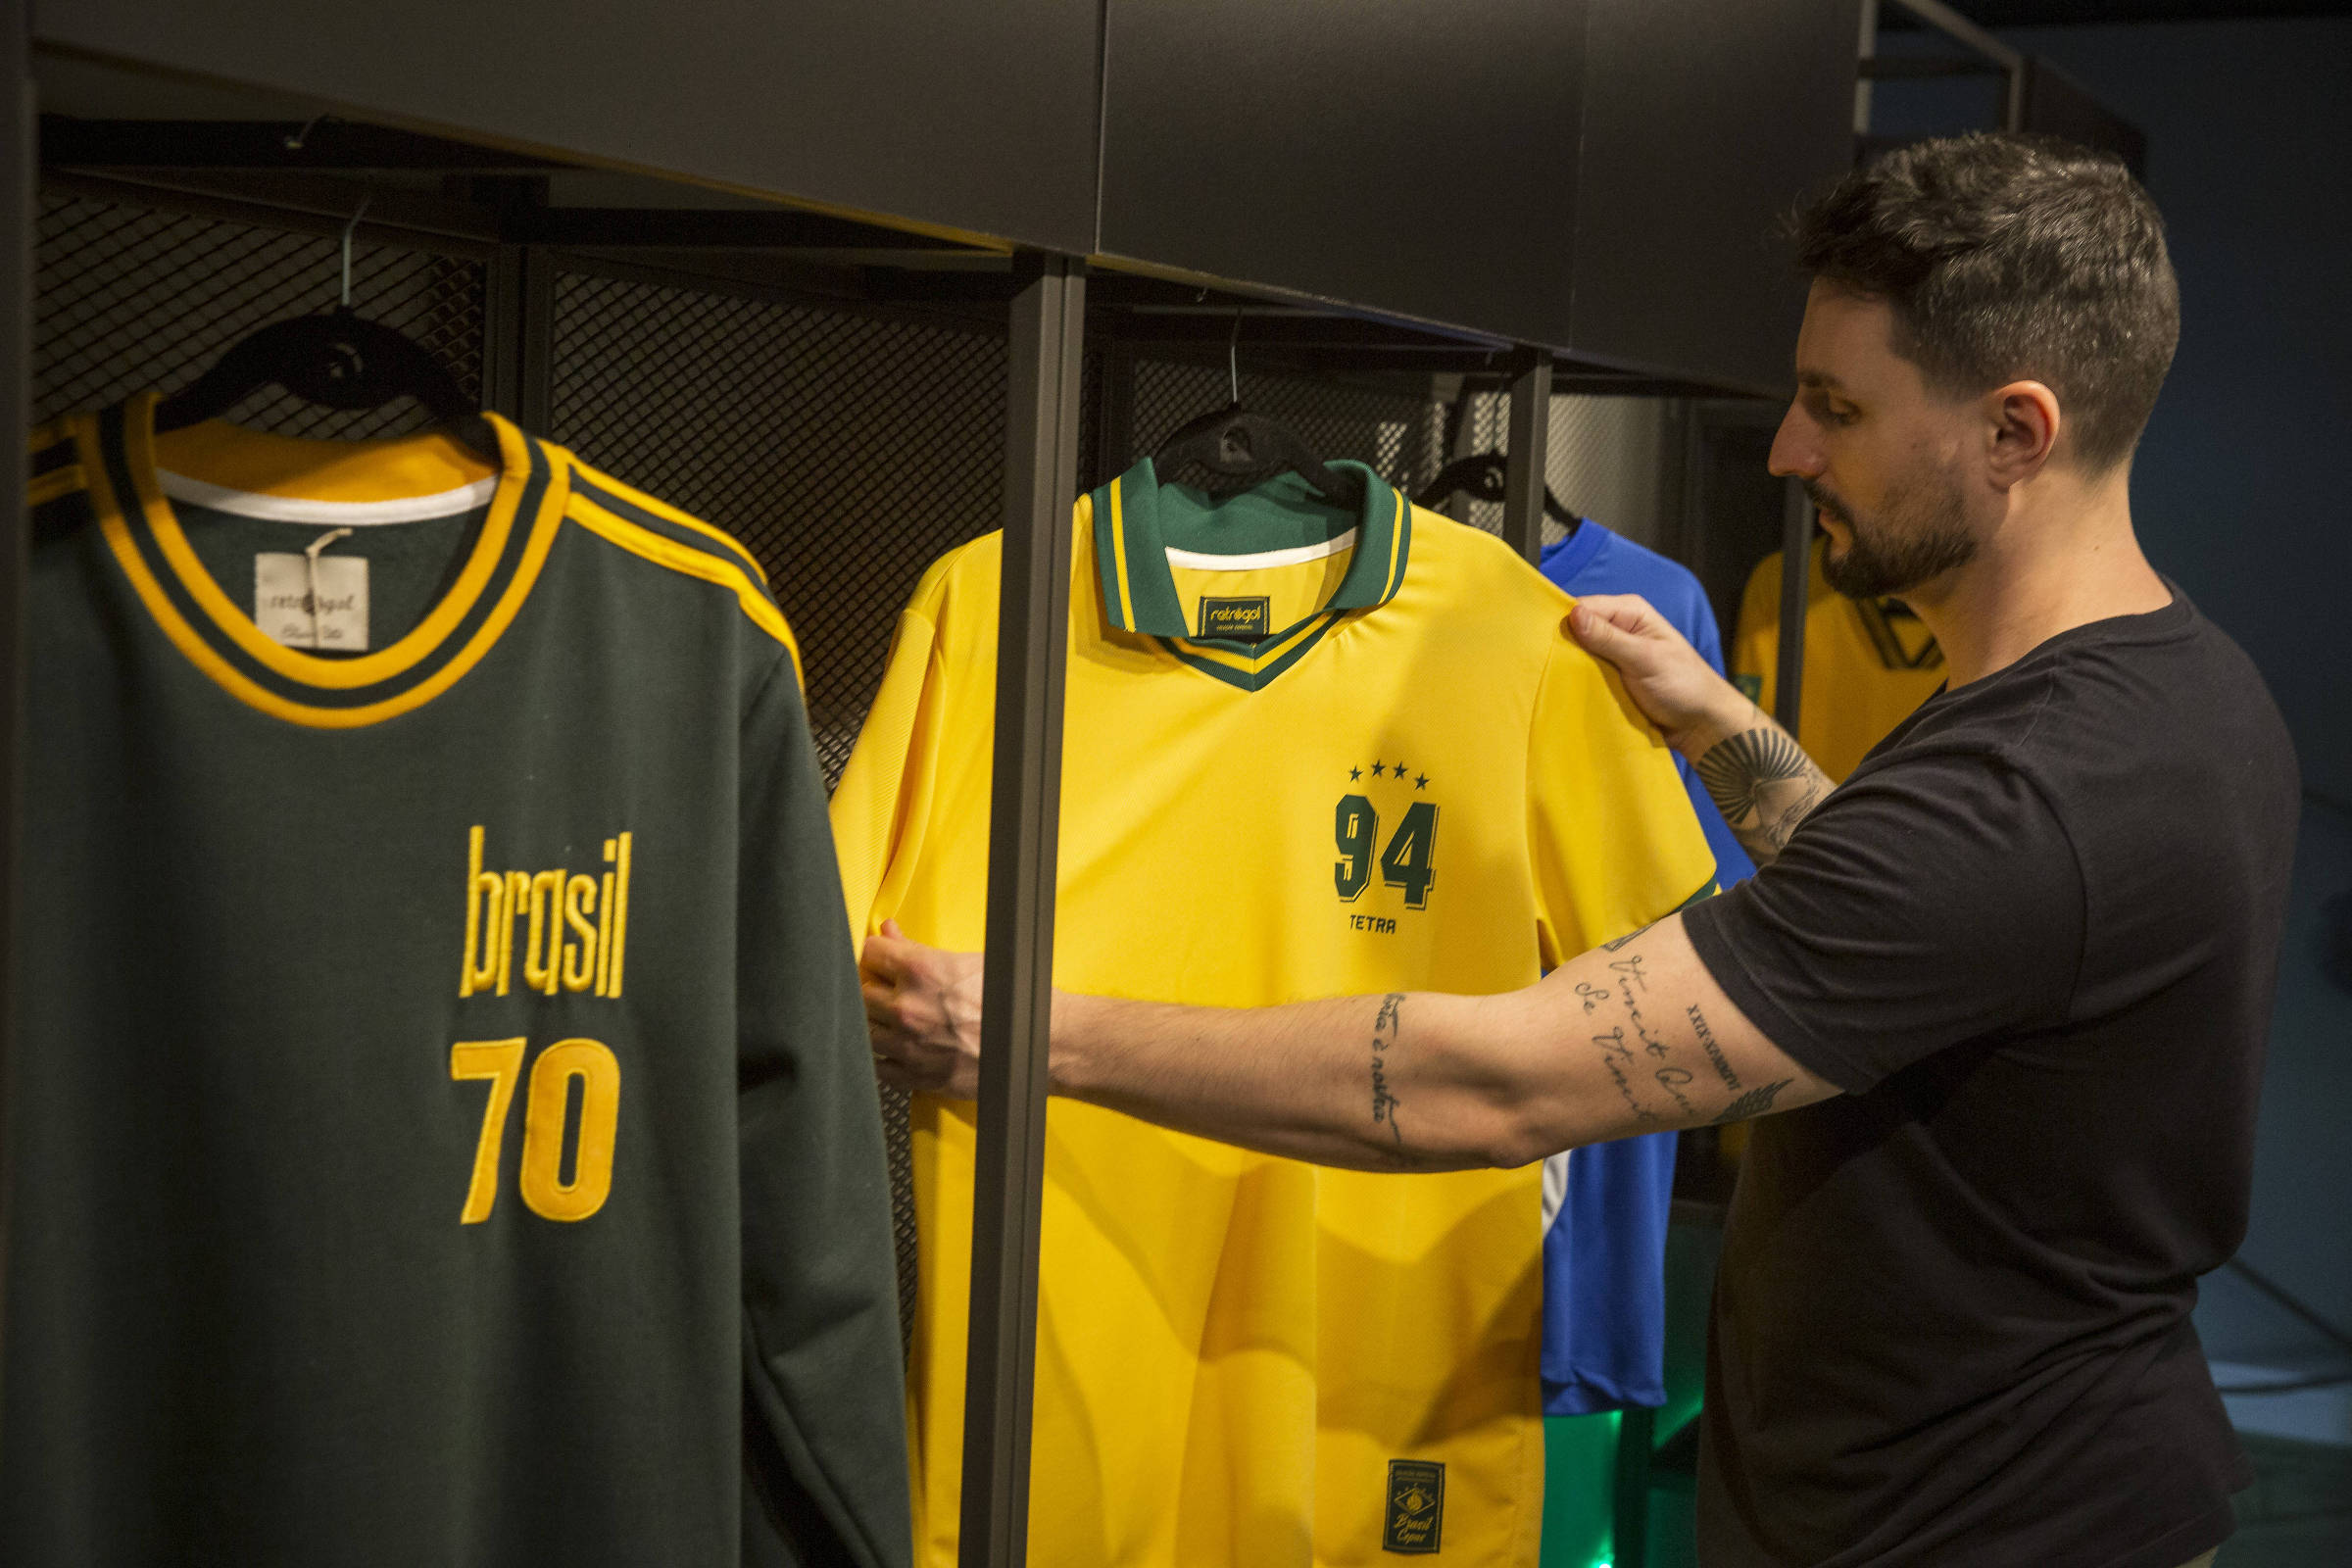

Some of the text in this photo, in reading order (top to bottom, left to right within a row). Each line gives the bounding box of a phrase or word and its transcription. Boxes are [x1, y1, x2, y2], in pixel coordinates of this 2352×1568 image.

[459, 825, 632, 999] brasil
[1335, 794, 1441, 911] 94
[1349, 914, 1397, 935] TETRA
[451, 1036, 621, 1225] 70
